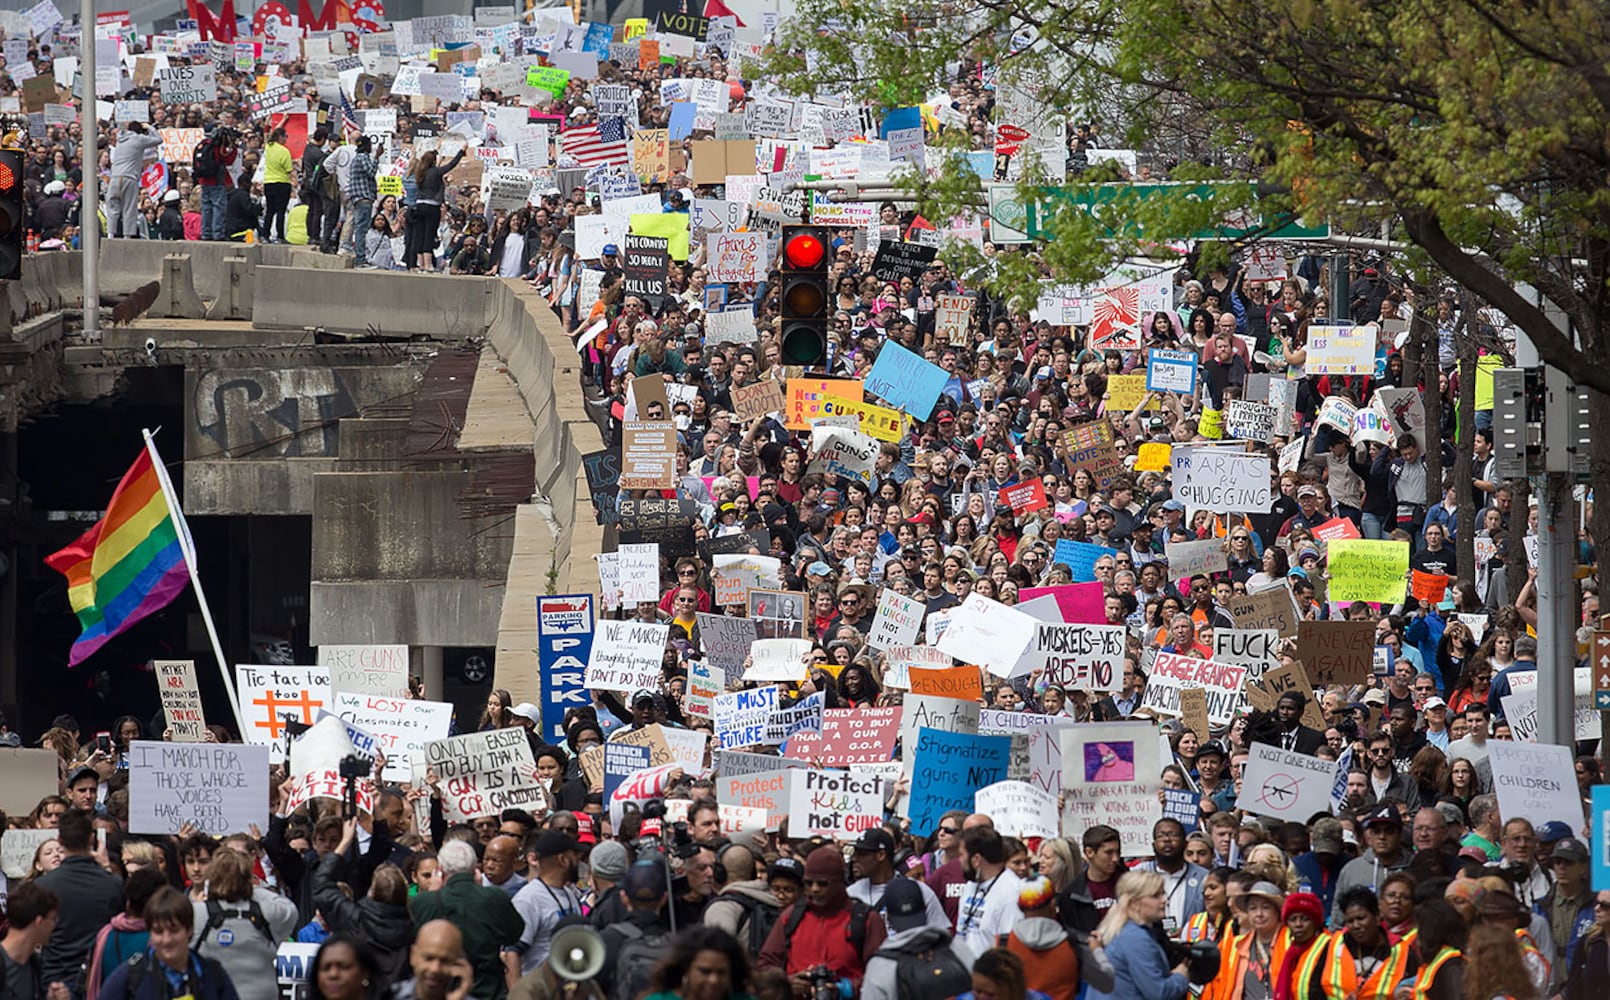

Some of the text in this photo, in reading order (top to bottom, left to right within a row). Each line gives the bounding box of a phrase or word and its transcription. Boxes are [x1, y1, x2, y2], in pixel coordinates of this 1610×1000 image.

[178, 20, 197, 29] WE
[662, 12, 708, 37] VOTE
[160, 68, 194, 80] LIVES
[169, 81, 192, 91] OVER
[598, 87, 629, 101] PROTECT
[160, 130, 203, 145] NEVER
[637, 131, 666, 142] WE
[163, 145, 195, 160] AGA
[477, 148, 499, 157] NRA
[814, 206, 843, 215] MOMS
[628, 255, 639, 265] SO
[625, 280, 663, 294] KILL US
[942, 298, 970, 310] END
[869, 378, 895, 397] NOT
[1232, 401, 1279, 416] THOUGHTS
[1253, 422, 1274, 432] STOP
[819, 449, 840, 461] KILL
[834, 441, 870, 461] GUNS
[1068, 447, 1099, 464] VOTE
[586, 455, 619, 489] IS
[1198, 457, 1265, 478] ARMS
[1192, 486, 1269, 507] HUGGING
[888, 595, 910, 612] PACK
[878, 604, 916, 629] LUNCHES
[1234, 606, 1254, 617] GUN
[701, 616, 717, 630] IF
[882, 621, 900, 634] NOT
[606, 624, 667, 646] WE MARCH
[720, 631, 746, 643] NOT
[702, 639, 752, 656] WORRIE
[888, 647, 912, 661] MAKE
[1216, 634, 1278, 659] FUCK
[360, 647, 404, 671] GUNS
[1304, 655, 1371, 676] AGAIN
[240, 668, 330, 687] Tic tac toe
[1090, 660, 1113, 687] NO
[1154, 654, 1195, 680] RAGE
[1194, 660, 1245, 690] AGAINST
[167, 677, 184, 688] NRA
[620, 673, 658, 688] DO SHIT
[1269, 673, 1296, 693] WE
[1510, 676, 1534, 688] STOP
[274, 690, 298, 699] too
[341, 696, 360, 706] We
[367, 697, 406, 713] LOST
[185, 709, 200, 721] KILL
[823, 708, 894, 718] ONLY THING
[912, 701, 946, 728] Arm
[995, 712, 1054, 728] CHILDREN
[849, 720, 863, 728] TO
[869, 719, 893, 728] BUY
[720, 725, 763, 749] FUTURE
[833, 732, 841, 740] A
[852, 729, 878, 738] GUN
[429, 736, 468, 761] ONLY
[487, 729, 526, 750] EASIER
[606, 744, 643, 757] MARCH
[797, 745, 810, 753] IS
[823, 744, 832, 752] A
[919, 735, 1000, 766] Stigmatize
[134, 746, 242, 770] I MARCH FOR
[437, 748, 523, 779] TO BUY THAN A
[606, 755, 648, 768] FOR OUR
[725, 755, 784, 769] YOUR RIGHT
[1259, 749, 1333, 774] NOT ONE MORE
[152, 771, 248, 788] THOSE WHOSE
[449, 766, 522, 796] GUN IS A
[806, 772, 883, 795] Protect
[918, 766, 1003, 790] guns NOT
[1499, 774, 1561, 792] CHILDREN
[730, 775, 784, 797] Protect
[1067, 785, 1146, 798] MY GENERATION
[175, 789, 223, 804] VOICES
[489, 786, 542, 809] CANDIDATE
[811, 791, 862, 812] Kids
[154, 804, 222, 817] HAVE BEEN
[1069, 801, 1151, 815] AFTER VOTING OUT
[1175, 804, 1198, 816] OUR
[808, 812, 842, 829] not
[1107, 816, 1147, 826] ANNOYING
